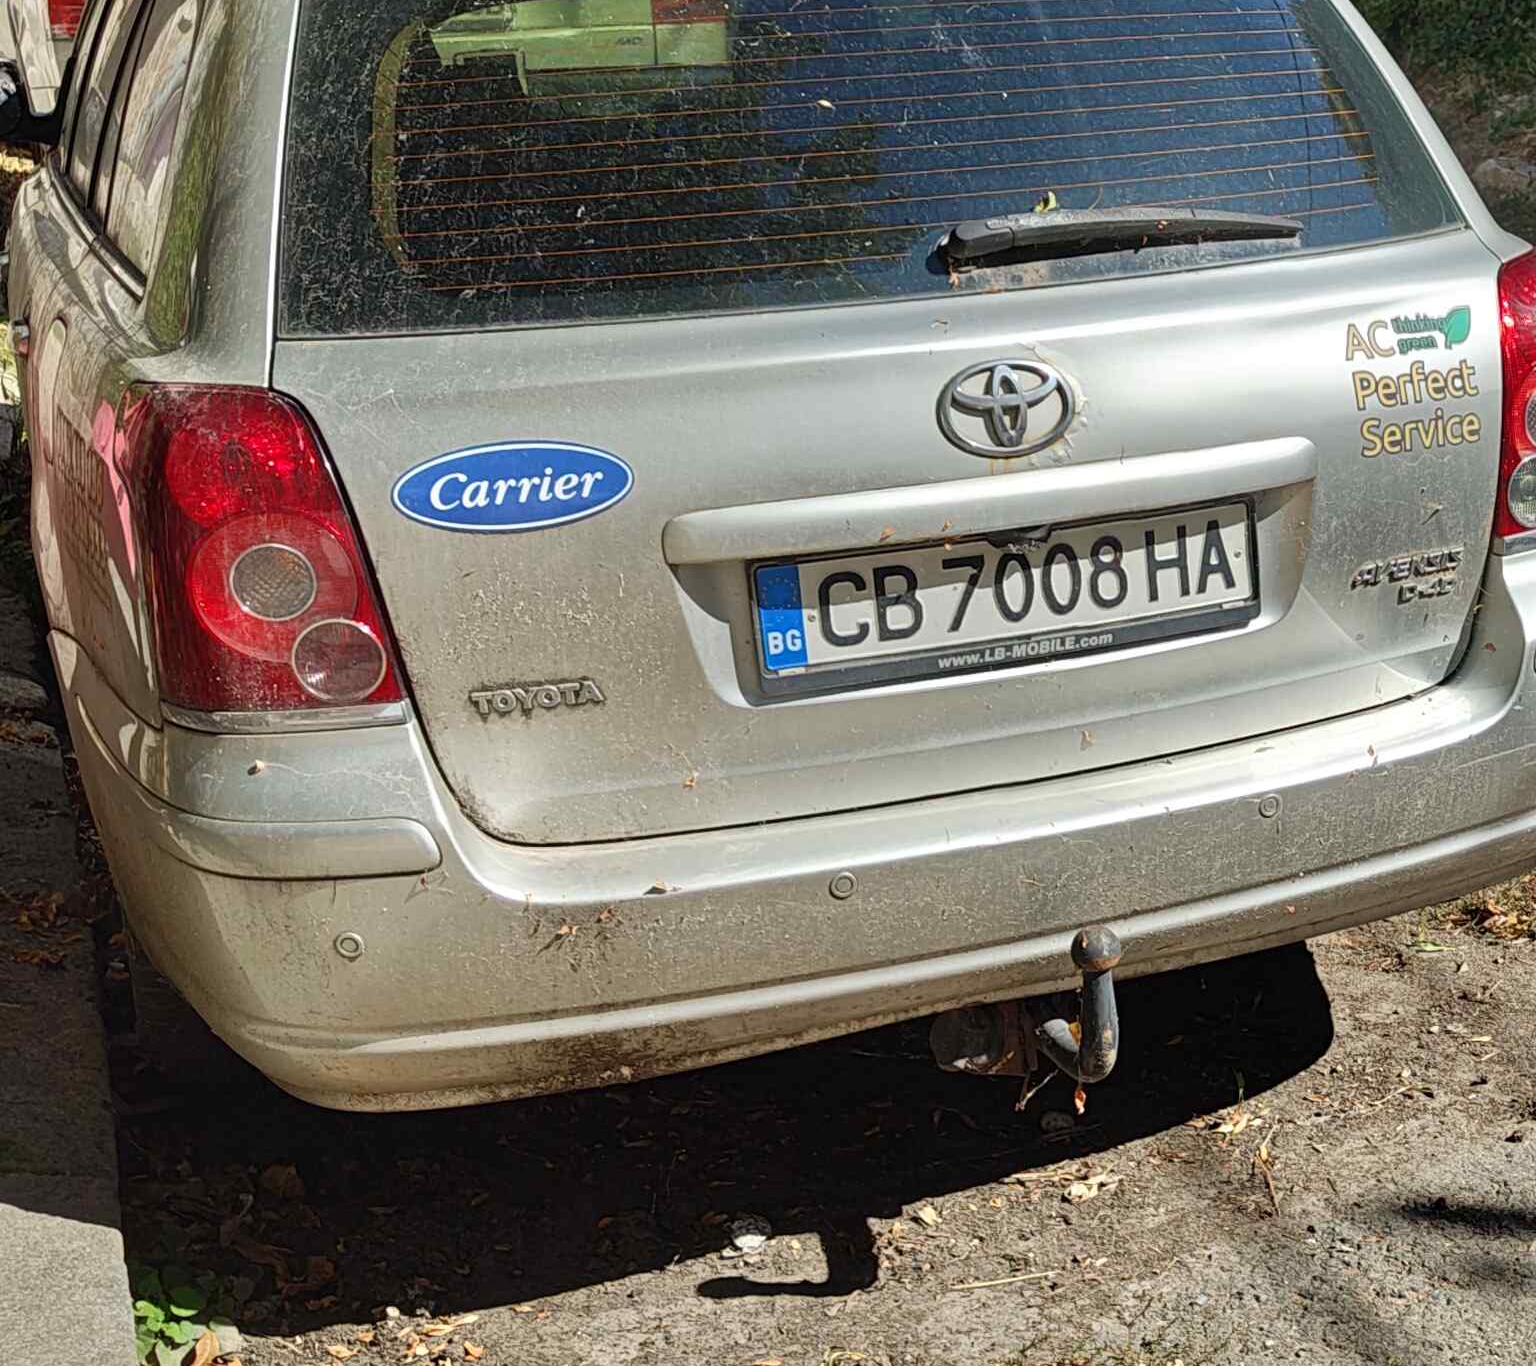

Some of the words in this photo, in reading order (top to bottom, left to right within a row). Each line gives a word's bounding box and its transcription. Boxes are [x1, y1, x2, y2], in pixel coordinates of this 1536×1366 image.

[1346, 320, 1395, 361] AC
[1397, 336, 1438, 355] green
[1352, 360, 1479, 411] Perfect
[1360, 408, 1481, 458] Service
[430, 467, 603, 510] Carrier
[817, 564, 924, 647] CB
[940, 535, 1129, 633] 7008
[1144, 520, 1237, 603] HA
[767, 629, 803, 655] BG
[937, 633, 1114, 670] www.LB-MOBILE.com
[469, 680, 605, 716] TOYOTA
